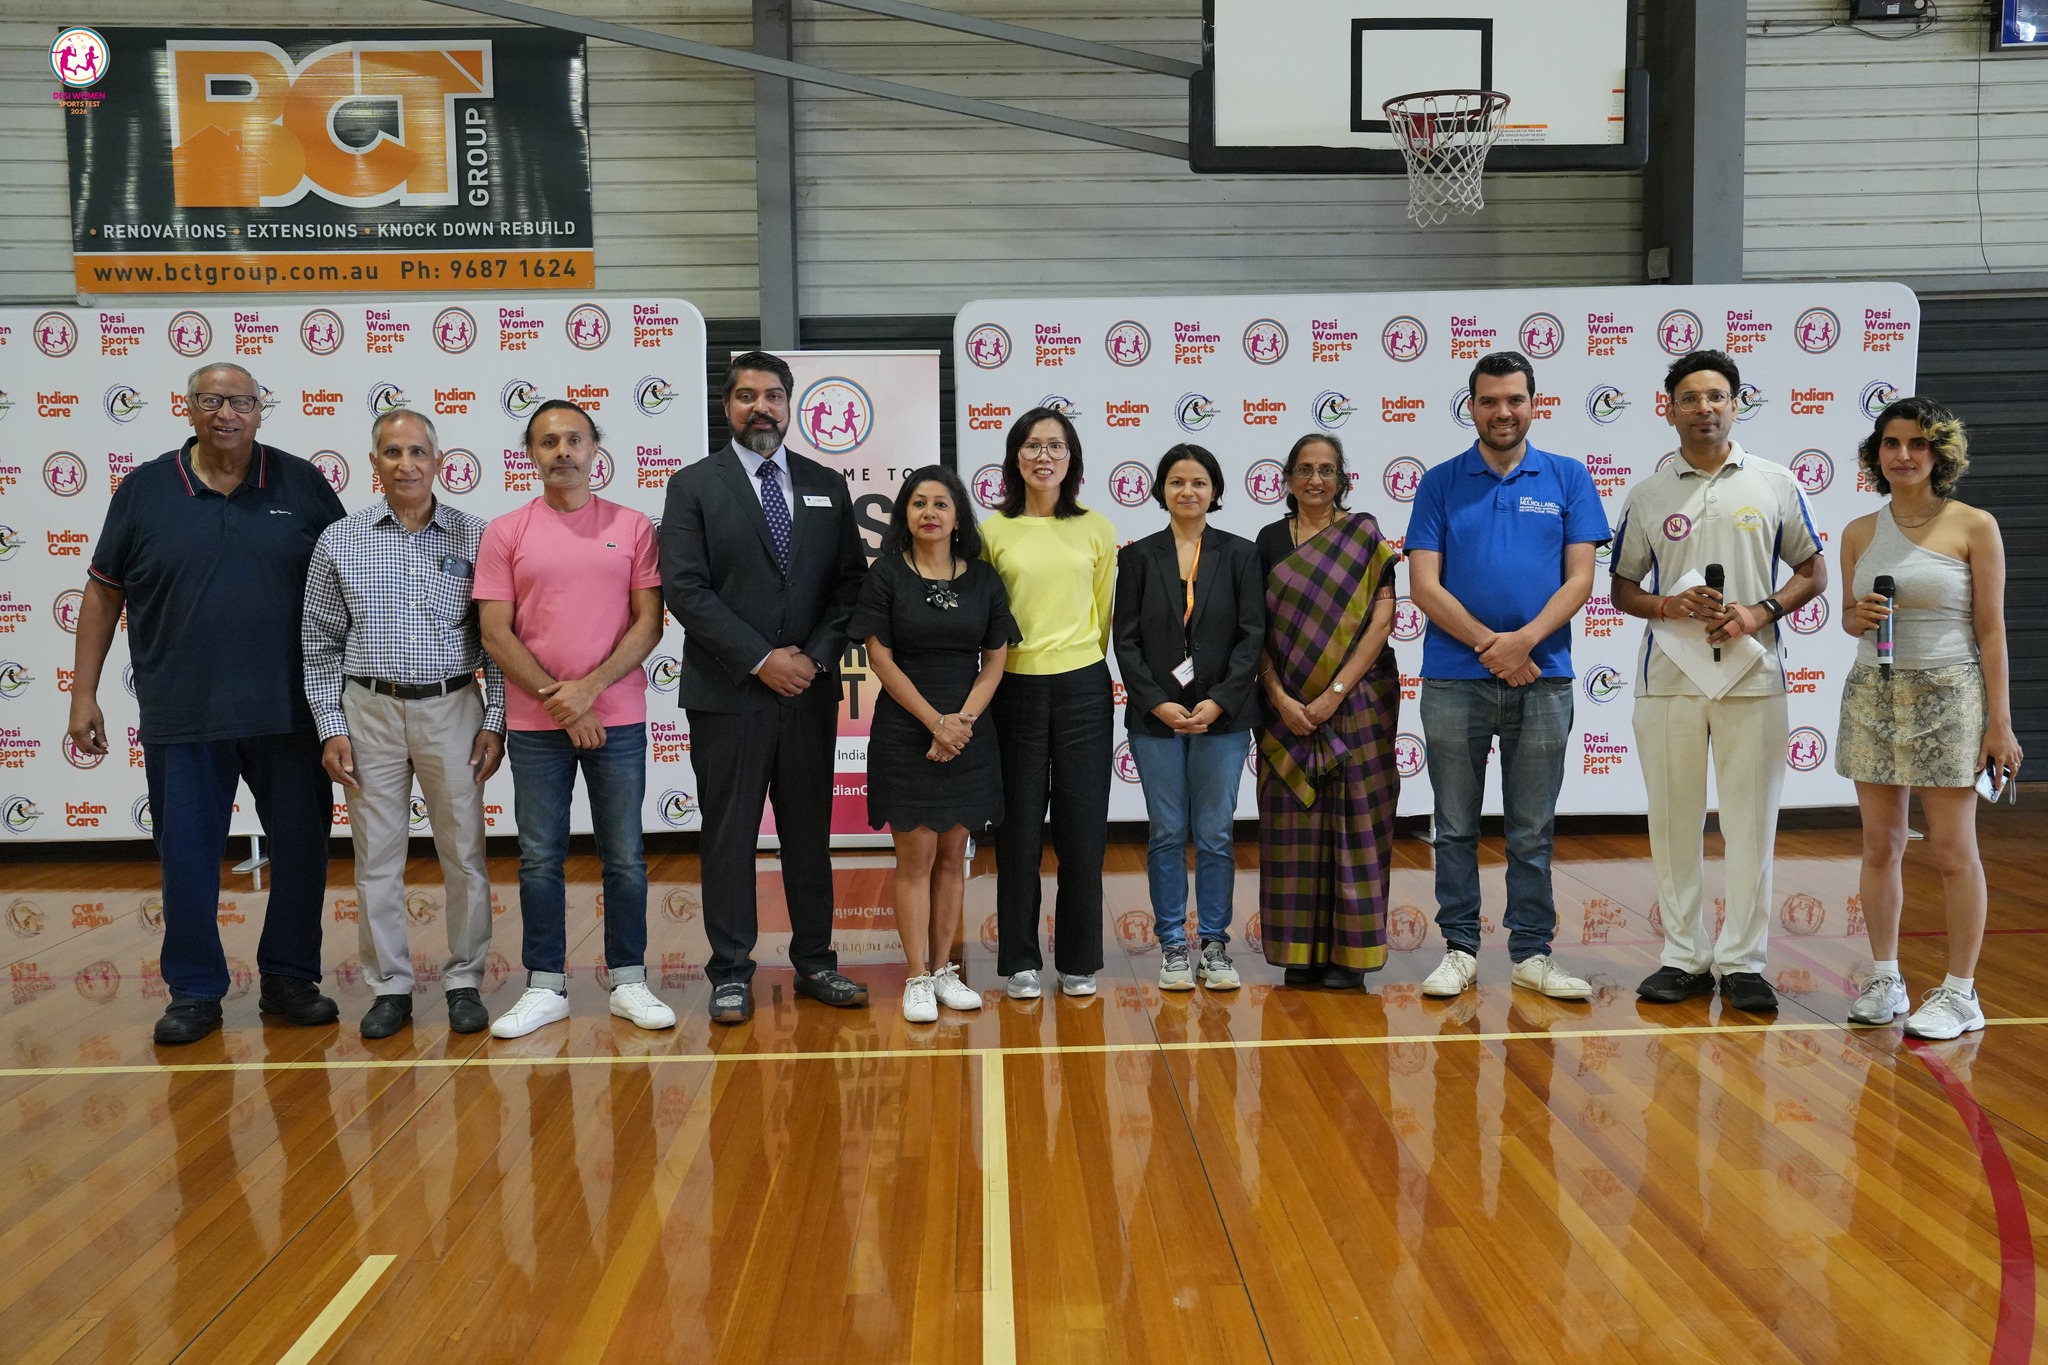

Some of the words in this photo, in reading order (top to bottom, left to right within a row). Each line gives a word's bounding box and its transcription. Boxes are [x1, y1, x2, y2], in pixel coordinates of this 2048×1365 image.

[166, 39, 494, 208] BCT
[466, 107, 490, 207] GROUP
[103, 223, 227, 239] RENOVATIONS
[247, 222, 358, 238] EXTENSIONS
[377, 222, 437, 238] KNOCK
[443, 221, 494, 237] DOWN
[500, 221, 576, 237] REBUILD
[94, 260, 379, 285] www.bctgroup.com.au
[401, 260, 440, 279] Ph:
[450, 260, 507, 278] 9687
[519, 259, 577, 277] 1624
[366, 310, 391, 320] Desi
[499, 307, 524, 318] Desi
[634, 304, 658, 315] Desi
[1865, 308, 1890, 319] Desi
[100, 313, 125, 324] Desi
[234, 312, 260, 323] Desi
[634, 316, 678, 326] Women
[1588, 313, 1613, 324] Desi
[1728, 310, 1752, 321] Desi
[366, 321, 411, 331] Women
[499, 318, 544, 328] Women
[1174, 321, 1200, 332] Desi
[1312, 319, 1337, 330] Desi
[1451, 316, 1476, 327] Desi
[1728, 322, 1772, 332] Women
[1865, 320, 1910, 330] Women
[100, 324, 145, 334] Women
[234, 324, 280, 334] Women
[634, 327, 674, 339] Sports
[1035, 324, 1060, 334] Desi
[1451, 328, 1496, 338] Women
[1588, 324, 1633, 334] Women
[236, 334, 274, 346] Sports
[367, 332, 406, 344] Sports
[500, 330, 539, 342] Sports
[1035, 335, 1080, 345] Women
[1174, 333, 1220, 343] Women
[1312, 331, 1357, 341] Women
[1727, 332, 1766, 344] Sports
[1864, 331, 1904, 343] Sports
[101, 336, 140, 348] Sports
[500, 340, 527, 350] Fest
[634, 338, 662, 348] Fest
[1452, 338, 1491, 350] Sports
[1588, 336, 1627, 348] Sports
[1864, 342, 1890, 352] Fest
[101, 346, 128, 356] Fest
[236, 346, 262, 356] Fest
[367, 343, 394, 353] Fest
[1036, 346, 1075, 358] Sports
[1176, 344, 1214, 356] Sports
[1313, 342, 1352, 354] Sports
[1588, 346, 1615, 356] Fest
[1726, 344, 1754, 354] Fest
[1176, 355, 1202, 365] Fest
[1313, 353, 1340, 363] Fest
[1452, 350, 1479, 360] Fest
[1036, 357, 1063, 367] Fest
[302, 390, 343, 403] Indian
[434, 388, 476, 402] Indian
[567, 384, 609, 399] Indian
[1791, 388, 1834, 402] Indian
[37, 391, 79, 405] Indian
[1382, 395, 1425, 409] Indian
[303, 403, 336, 416] Care
[434, 402, 467, 415] Care
[968, 403, 1011, 417] Indian
[1106, 400, 1149, 414] Indian
[1243, 398, 1286, 412] Indian
[1791, 402, 1824, 415] Care
[38, 405, 71, 418] Care
[1382, 409, 1416, 423] Care
[969, 417, 1003, 430] Care
[1106, 414, 1141, 427] Care
[1243, 412, 1278, 425] Care
[637, 445, 662, 456] Desi
[109, 452, 133, 463] Desi
[637, 457, 682, 467] Women
[1587, 454, 1612, 464] Desi
[638, 468, 676, 480] Sports
[1587, 465, 1631, 475] Women
[505, 482, 531, 492] Fest
[638, 478, 665, 488] Fest
[1593, 477, 1625, 487] ports
[1597, 486, 1613, 497] est
[47, 530, 89, 544] Indian
[48, 543, 81, 556] Care
[0, 601, 31, 611] omen
[1585, 616, 1624, 629] Sports
[1585, 627, 1612, 637] Fest
[651, 721, 676, 732] Desi
[652, 732, 691, 743] Wome
[1584, 732, 1609, 743] Desi
[653, 743, 691, 756] Sports
[1584, 743, 1628, 754] Women
[654, 753, 680, 763] Fest
[838, 750, 866, 761] India
[1584, 754, 1622, 767] Sports
[1583, 764, 1610, 775] Fest
[65, 802, 107, 815] Indian
[66, 815, 99, 828] Care
